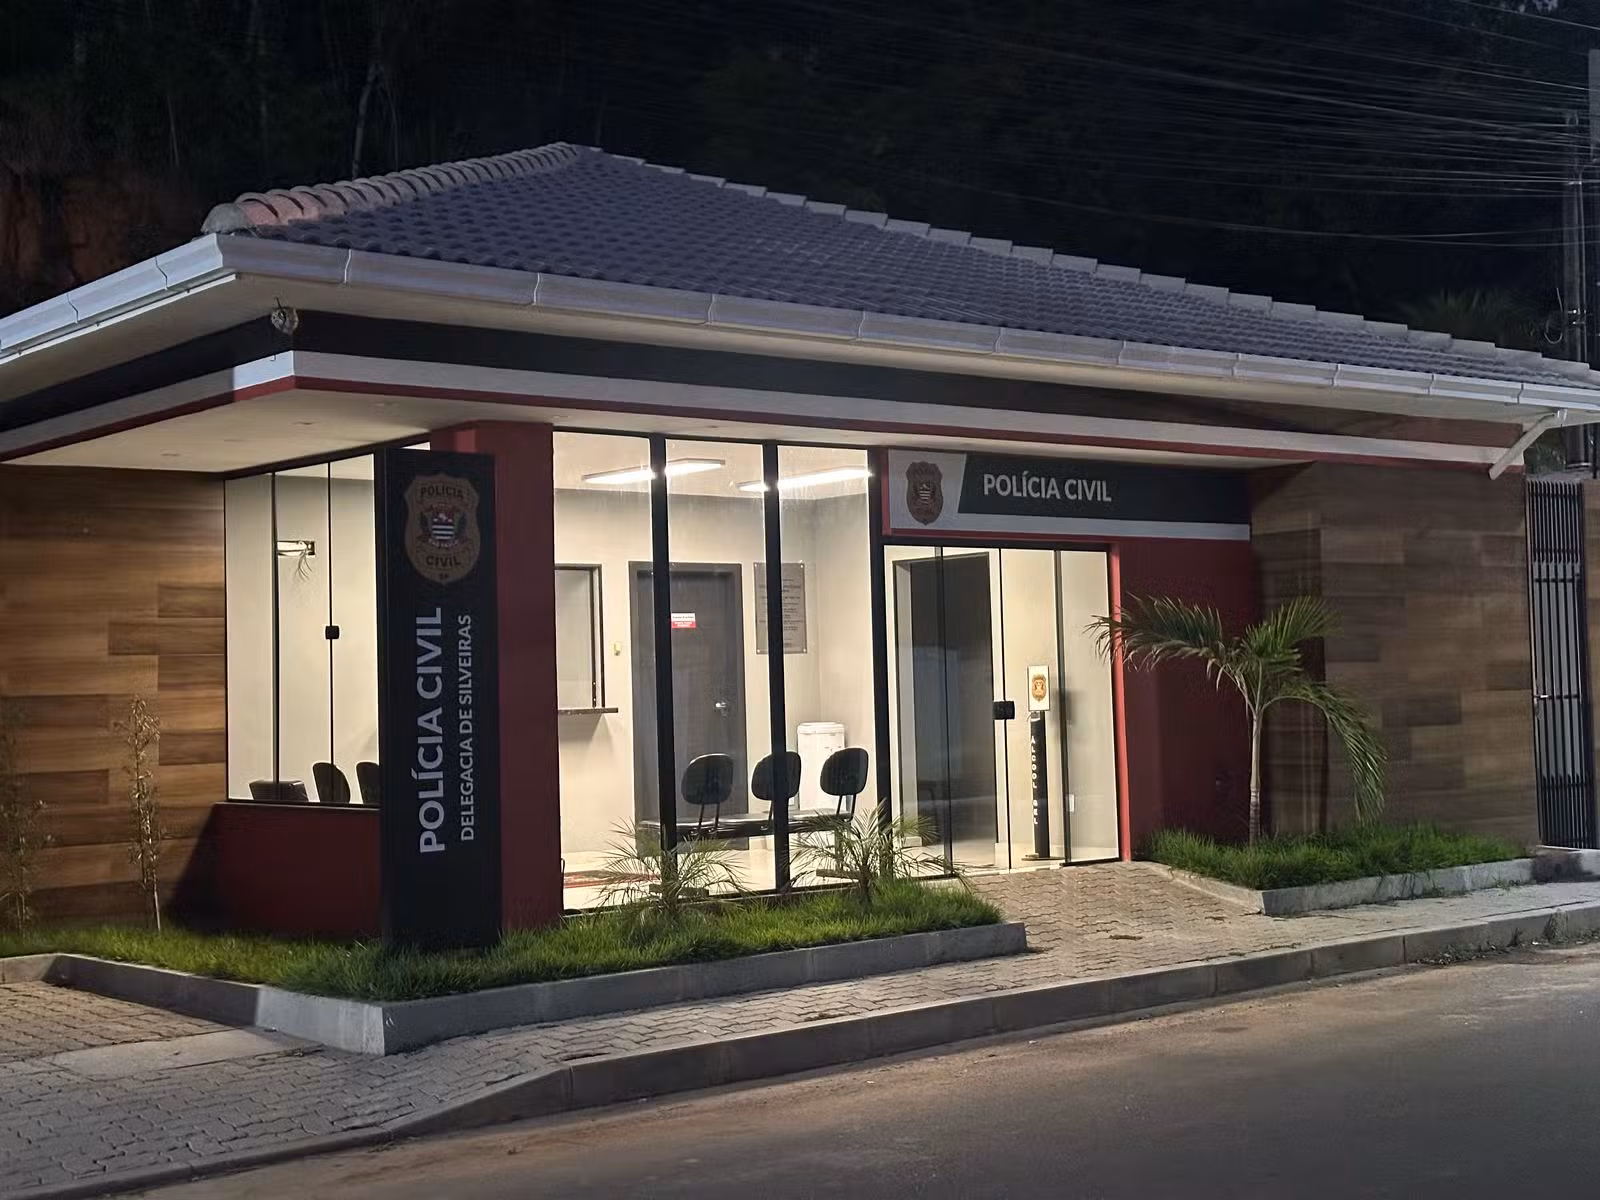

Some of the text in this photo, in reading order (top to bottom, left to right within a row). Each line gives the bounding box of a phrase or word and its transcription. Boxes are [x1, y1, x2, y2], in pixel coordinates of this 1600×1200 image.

[983, 471, 1112, 501] POLÍCIA CIVIL
[426, 555, 461, 567] CIVIL
[410, 607, 445, 853] POLÍCIA CIVIL
[458, 614, 474, 841] DELEGACIA DE SILVEIRAS
